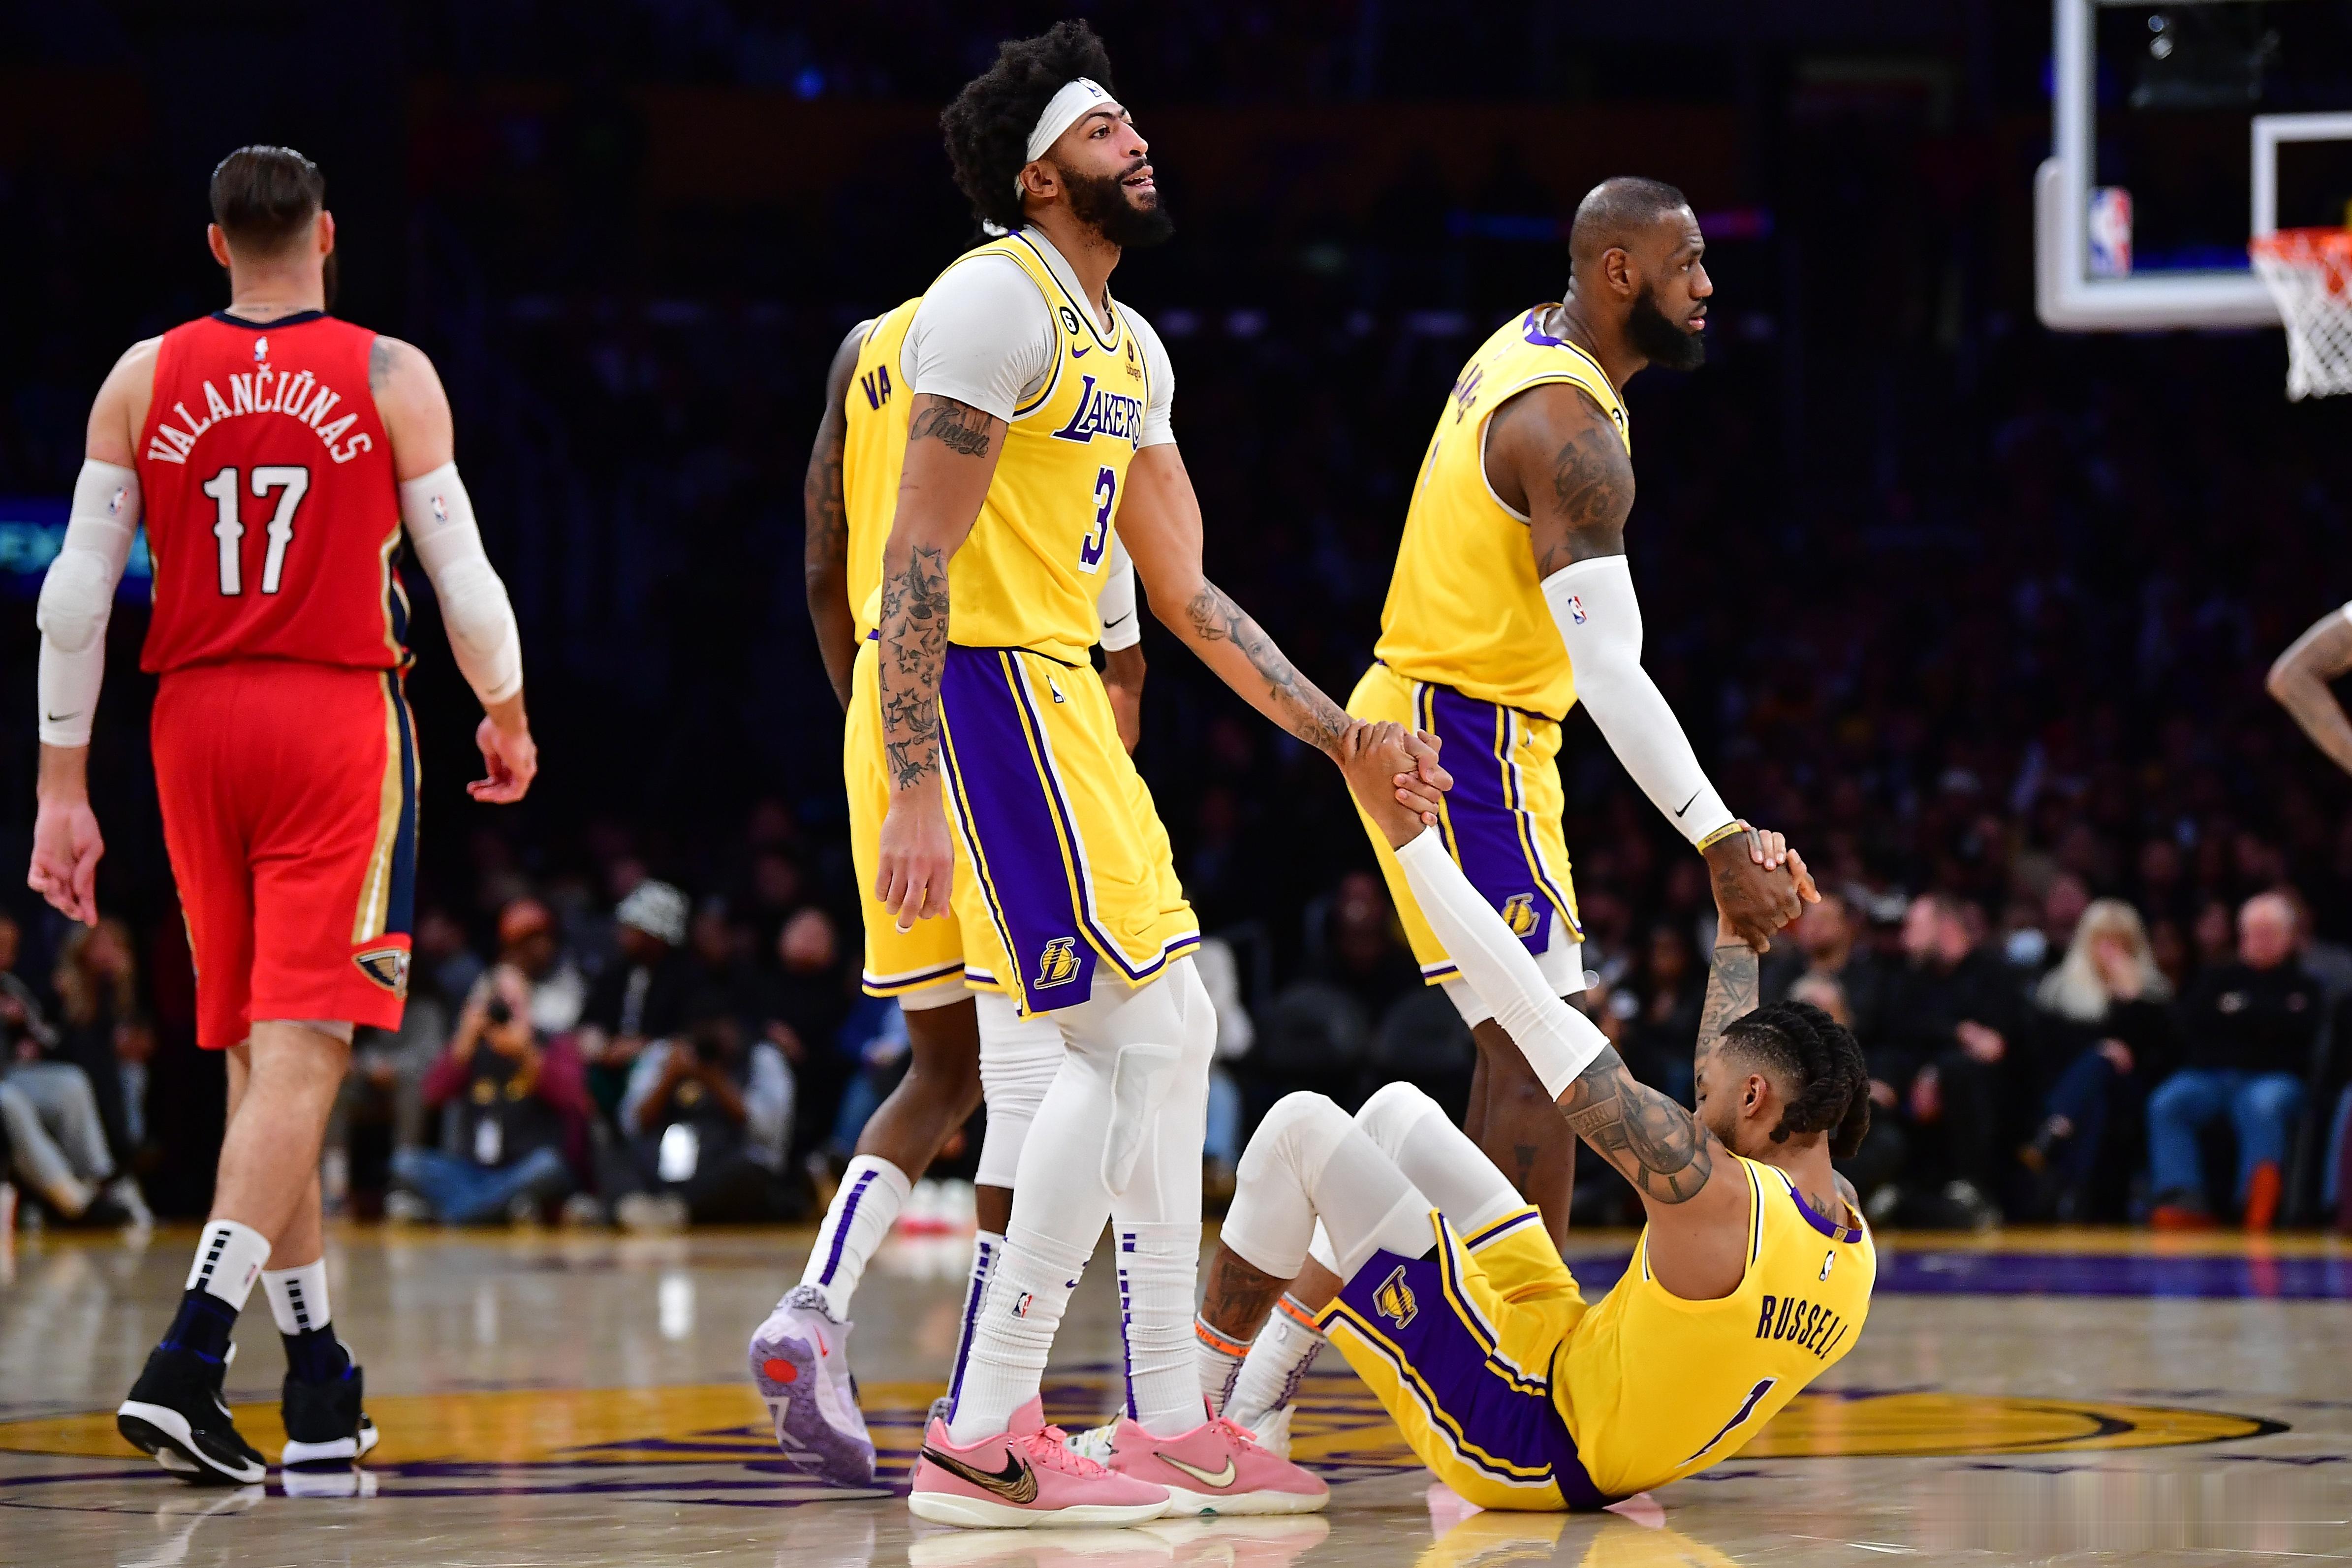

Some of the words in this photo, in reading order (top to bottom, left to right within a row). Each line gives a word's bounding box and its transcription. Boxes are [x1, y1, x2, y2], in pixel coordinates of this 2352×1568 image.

[1049, 373, 1142, 452] LAKERS
[202, 466, 311, 596] 17
[1077, 465, 1117, 574] 3
[1756, 1294, 1849, 1360] RUSSELL
[1675, 1377, 1778, 1468] 1
